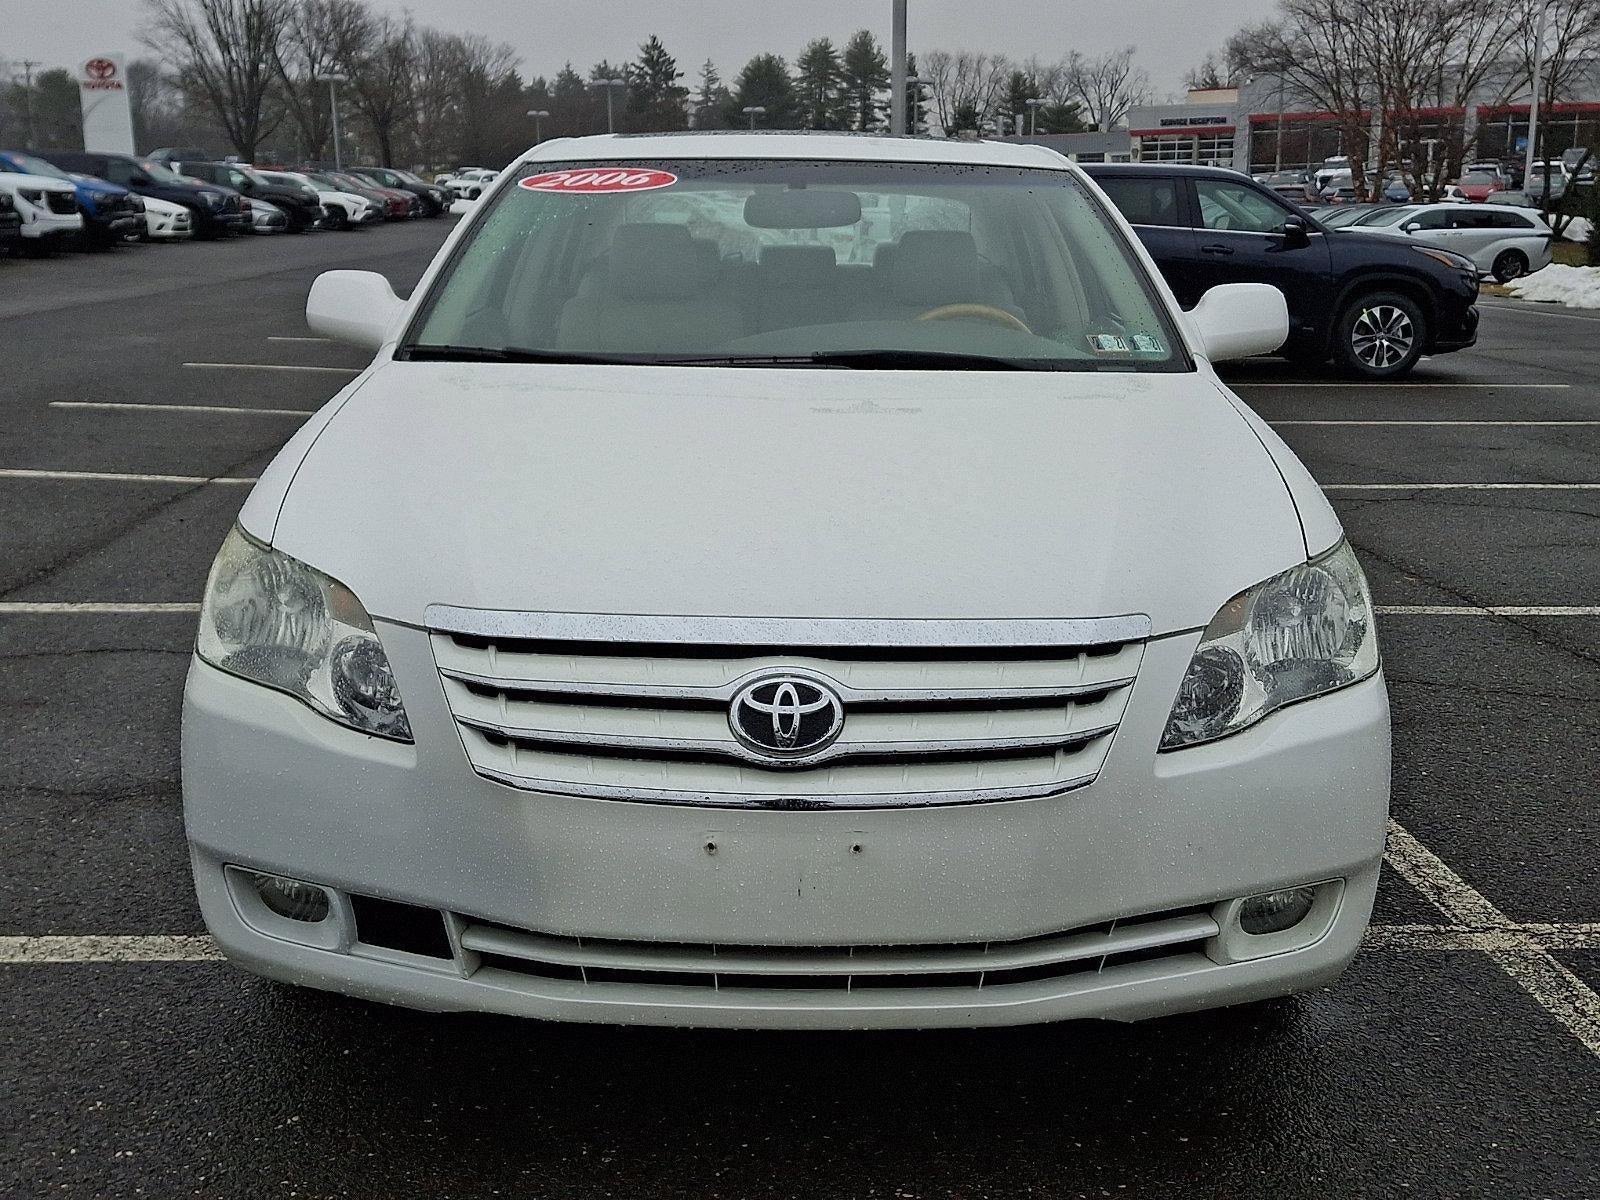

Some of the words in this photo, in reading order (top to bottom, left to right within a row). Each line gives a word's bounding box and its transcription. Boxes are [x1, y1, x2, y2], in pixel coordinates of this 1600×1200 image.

[1160, 118, 1188, 126] SERVICE
[1189, 117, 1227, 125] RECEPTION
[530, 172, 654, 187] 2006
